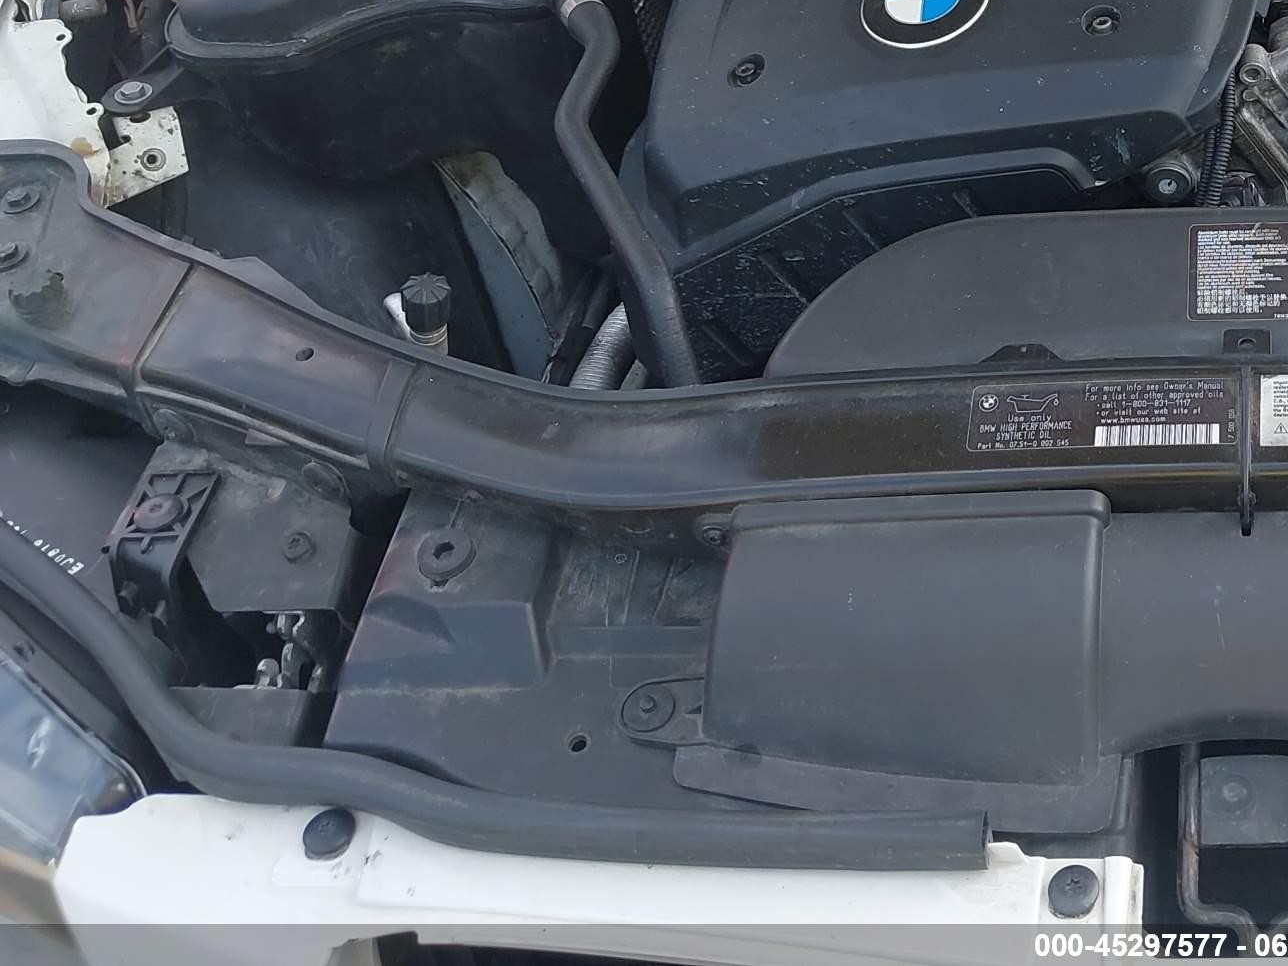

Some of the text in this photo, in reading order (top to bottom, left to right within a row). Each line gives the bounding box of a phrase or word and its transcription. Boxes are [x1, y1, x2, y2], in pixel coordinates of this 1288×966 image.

[1197, 381, 1225, 390] Manual
[1085, 393, 1098, 401] For
[1111, 392, 1126, 400] list
[1130, 391, 1139, 399] of
[1143, 390, 1164, 399] other
[1168, 390, 1204, 401] approved
[1007, 412, 1052, 425] Use only
[979, 420, 1073, 434] BMW HIGH PERFORMANCE
[995, 430, 1052, 441] SYNTHETIC OIL
